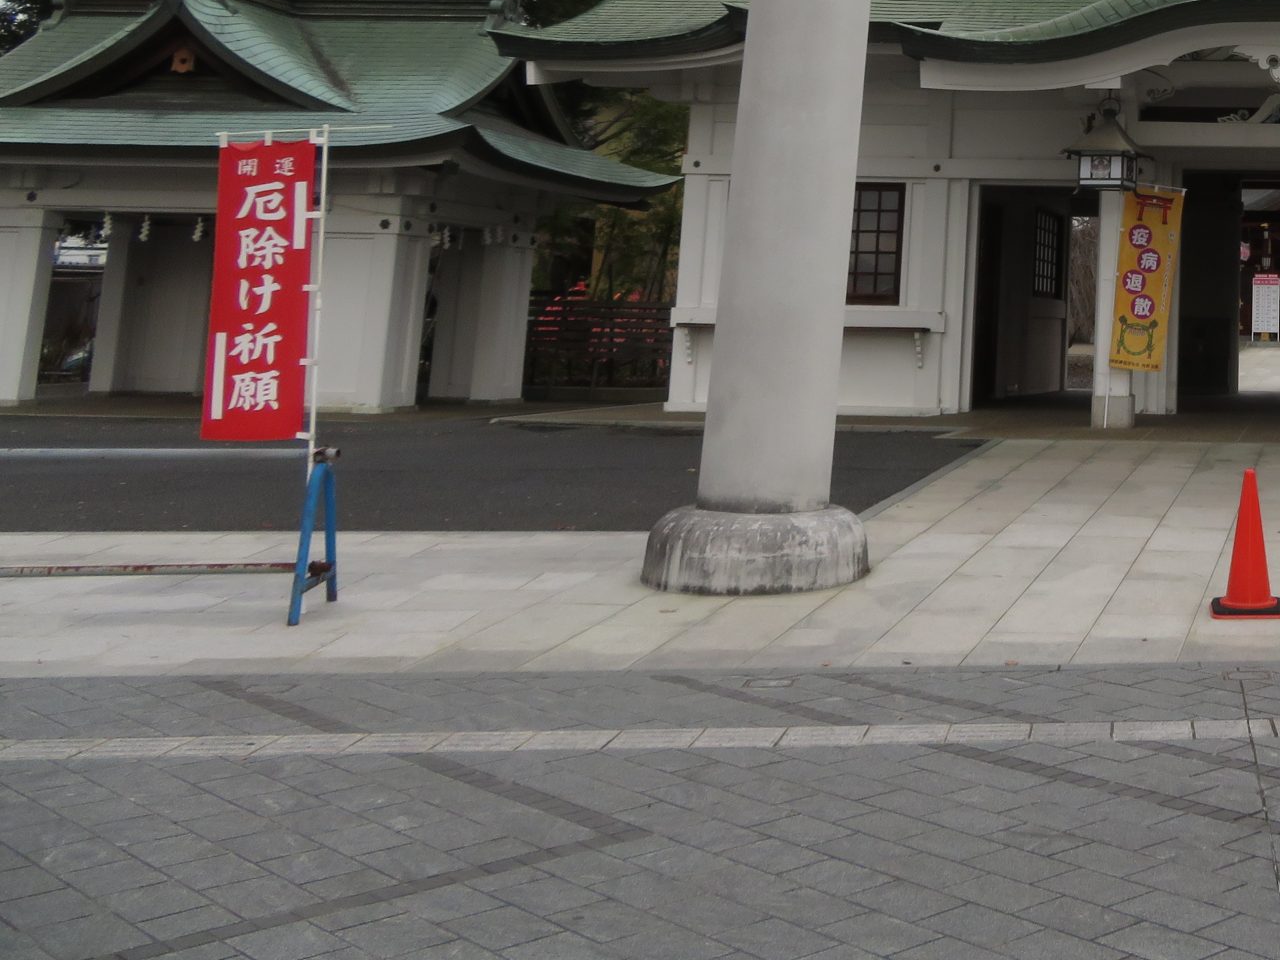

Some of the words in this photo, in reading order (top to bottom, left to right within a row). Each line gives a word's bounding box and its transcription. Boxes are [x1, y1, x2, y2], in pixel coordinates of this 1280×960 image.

[237, 157, 297, 177] 開運
[227, 180, 290, 412] 厄除け祈願
[1125, 228, 1159, 316] 疫病退散
